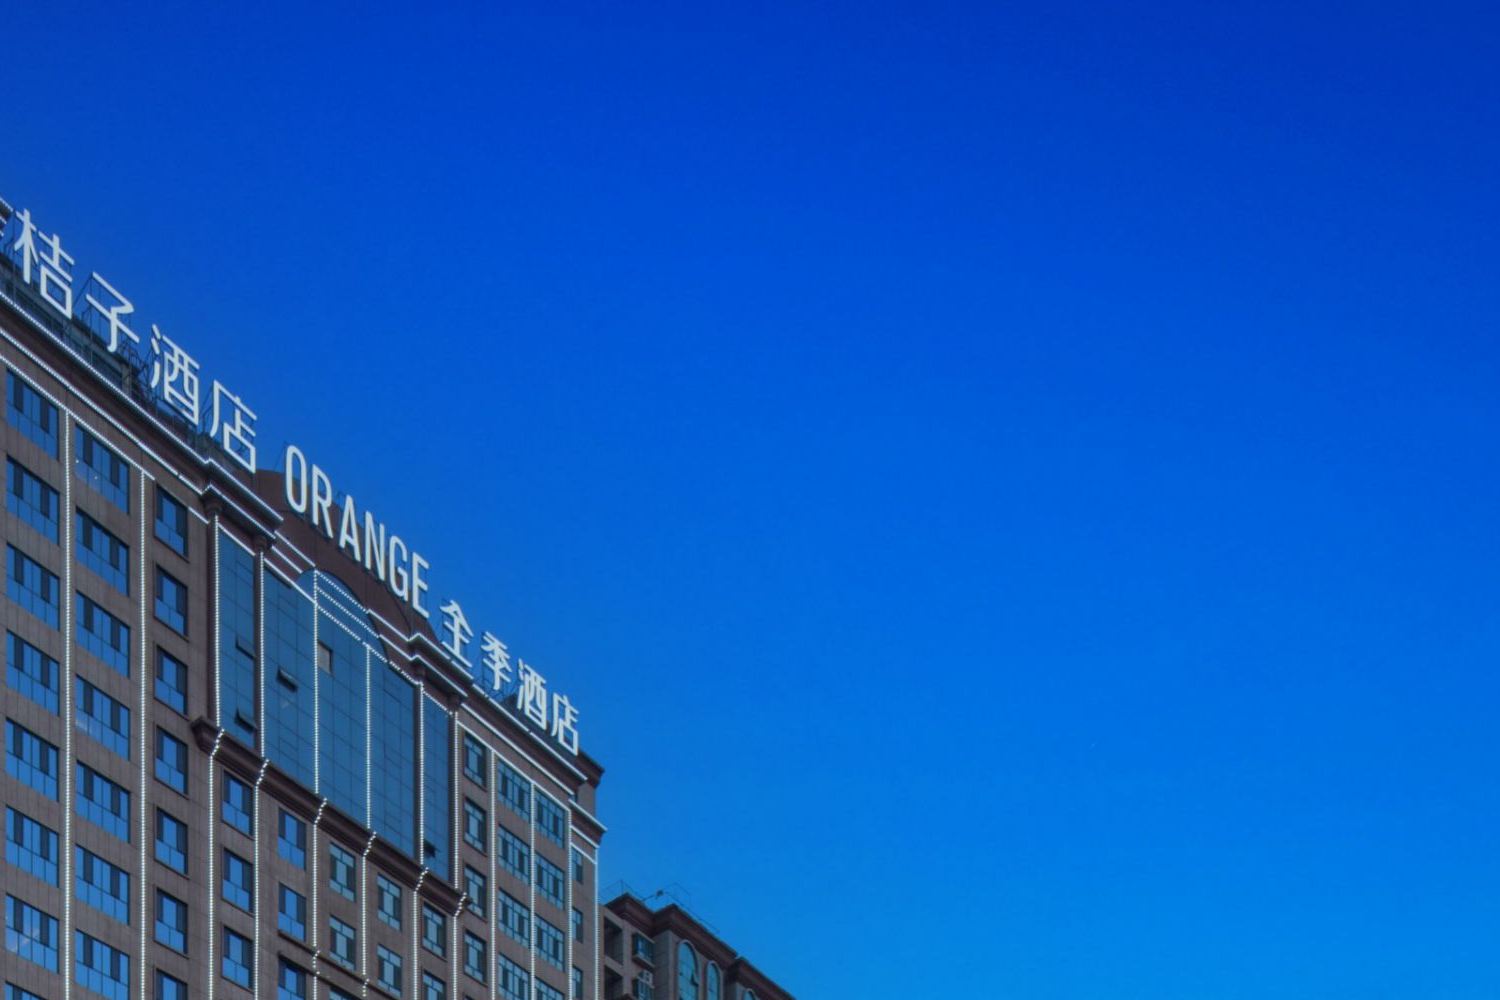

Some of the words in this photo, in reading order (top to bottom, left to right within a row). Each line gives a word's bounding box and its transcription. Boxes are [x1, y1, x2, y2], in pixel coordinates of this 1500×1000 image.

[14, 208, 257, 473] 桔子酒店
[285, 445, 430, 617] ORANGE
[439, 599, 579, 755] 全季酒店
